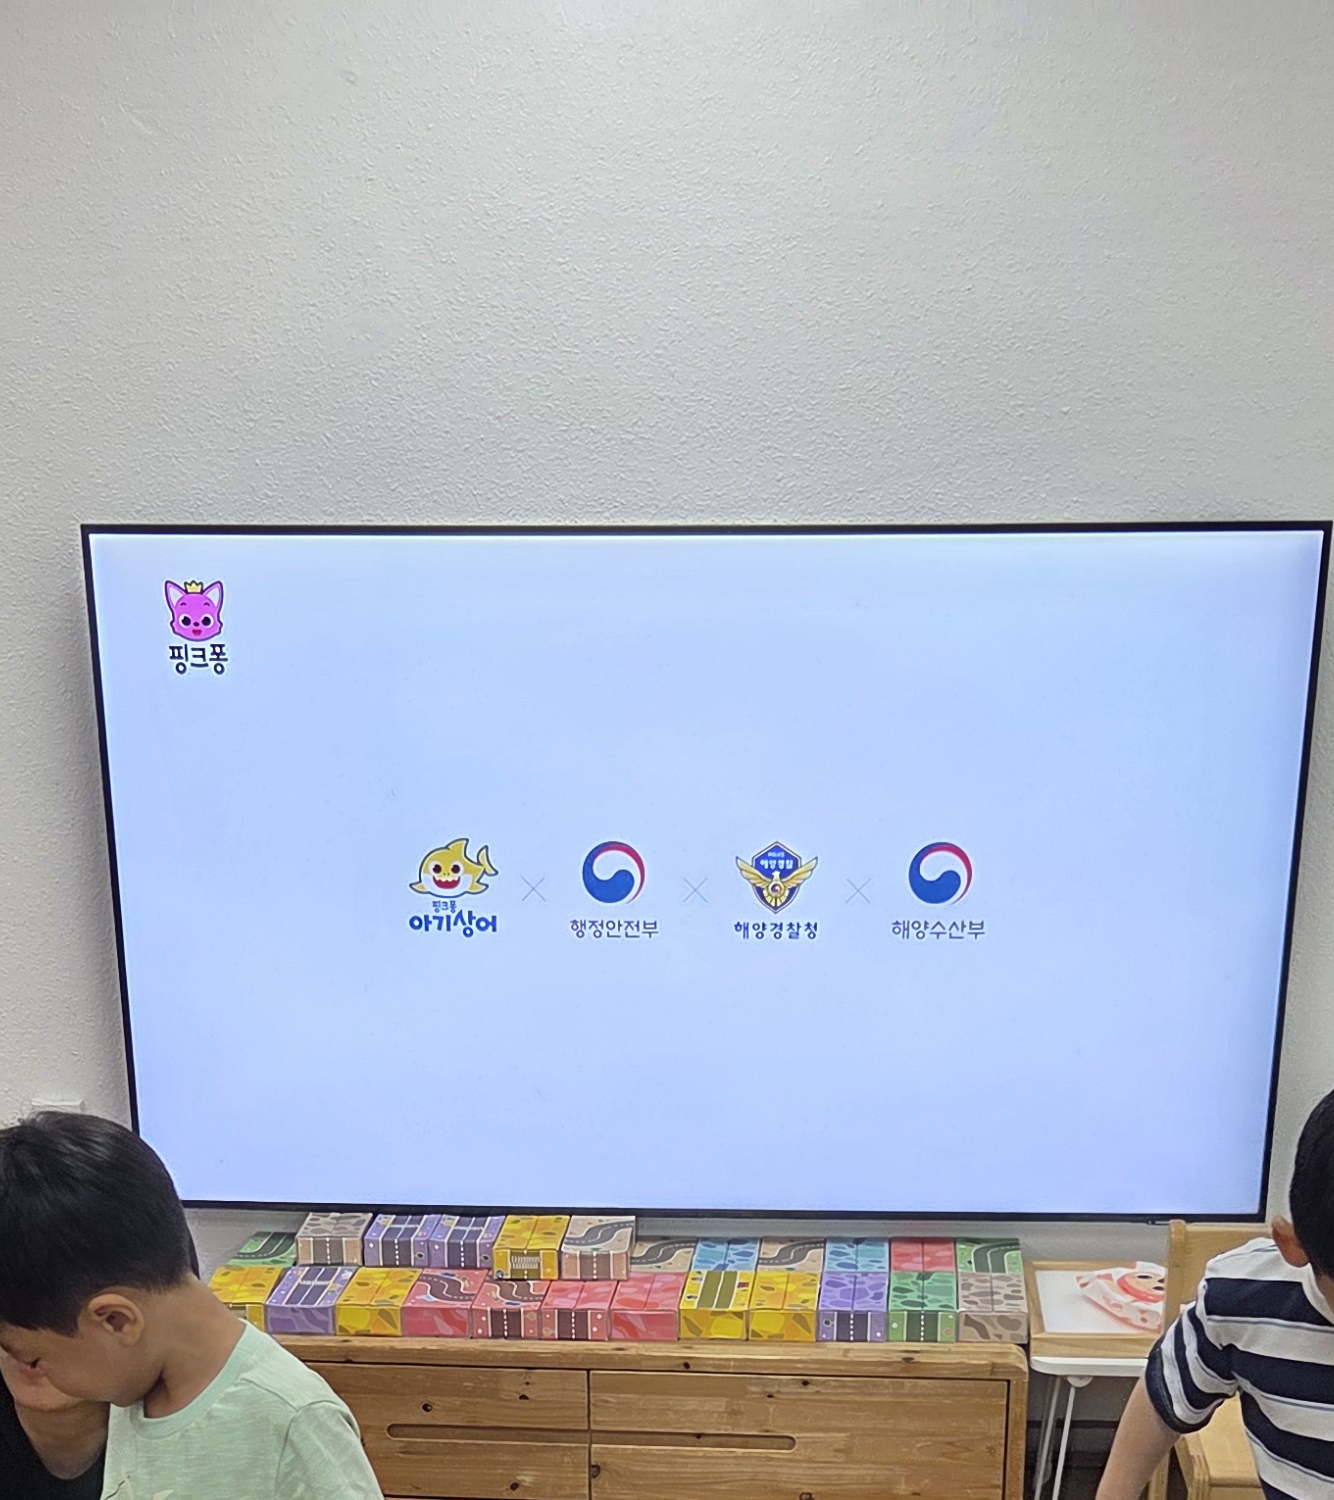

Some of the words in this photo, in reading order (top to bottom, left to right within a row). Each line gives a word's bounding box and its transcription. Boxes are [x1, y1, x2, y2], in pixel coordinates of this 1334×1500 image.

[169, 644, 229, 675] 핑크퐁
[432, 900, 457, 913] 핑크퐁
[409, 910, 498, 938] 아기상어
[570, 919, 659, 939] 행정안전부
[734, 921, 818, 940] 해양경찰청
[891, 920, 986, 940] 해양수산부
